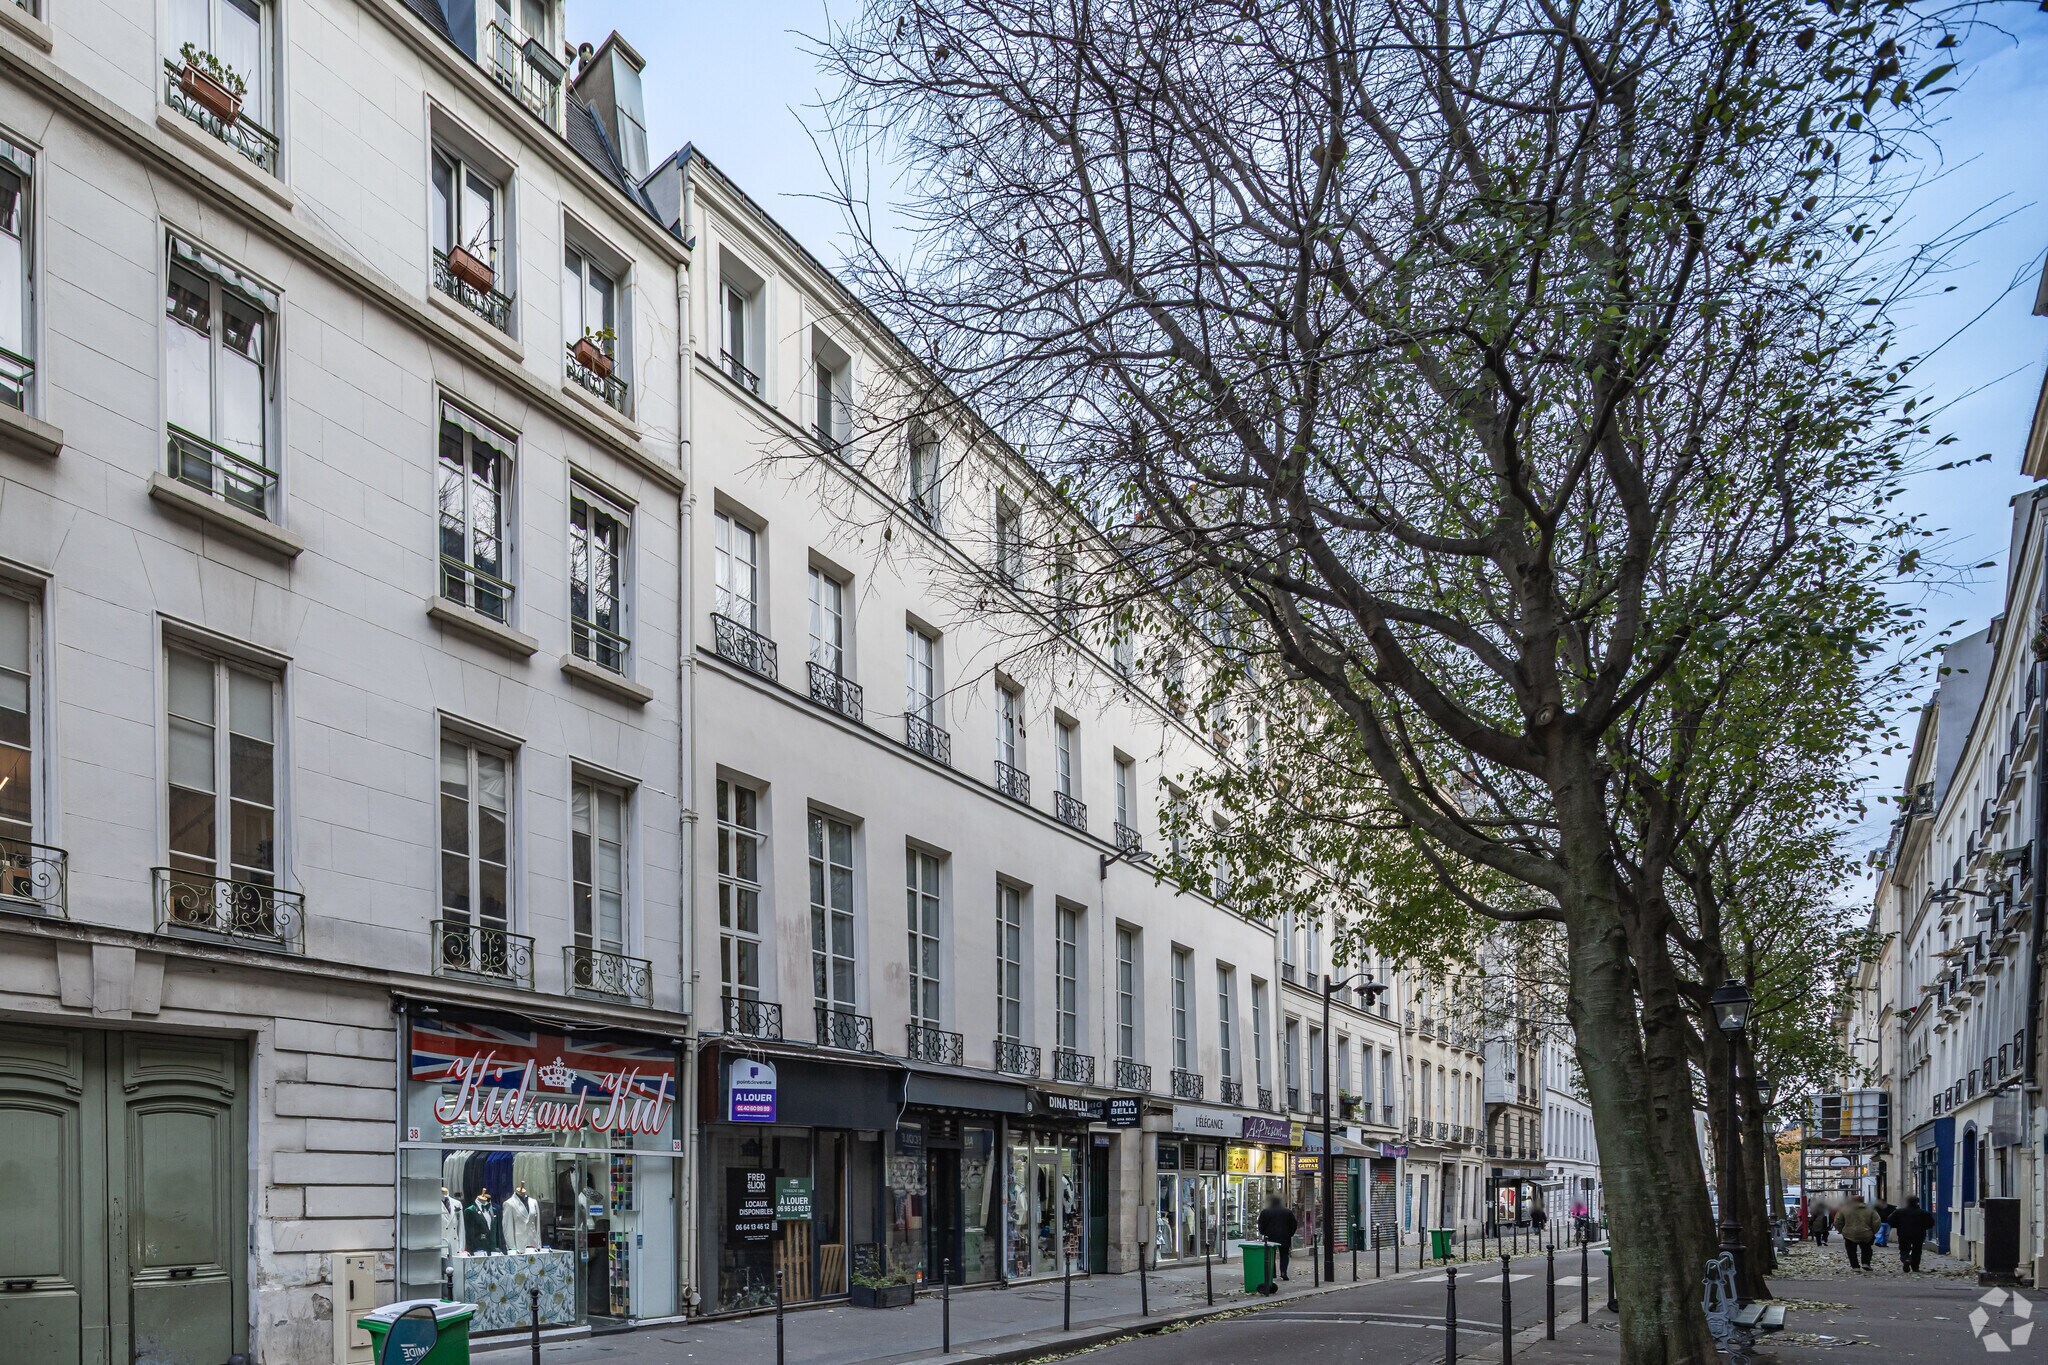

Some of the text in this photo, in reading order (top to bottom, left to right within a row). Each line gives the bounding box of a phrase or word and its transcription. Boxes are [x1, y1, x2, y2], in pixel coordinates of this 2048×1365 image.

[433, 1050, 672, 1135] Kid and Kid
[735, 1093, 773, 1102] A LOUER
[1049, 1096, 1067, 1110] DINA
[1068, 1098, 1088, 1112] BELLI
[1110, 1107, 1137, 1115] BELLI
[1195, 1114, 1224, 1130] L'ÉLÉGANCE
[409, 1129, 419, 1139] 38
[673, 1141, 681, 1150] 38
[747, 1173, 766, 1181] FRED
[780, 1195, 808, 1205] À LOUER
[739, 1208, 774, 1216] DISPONIBLES
